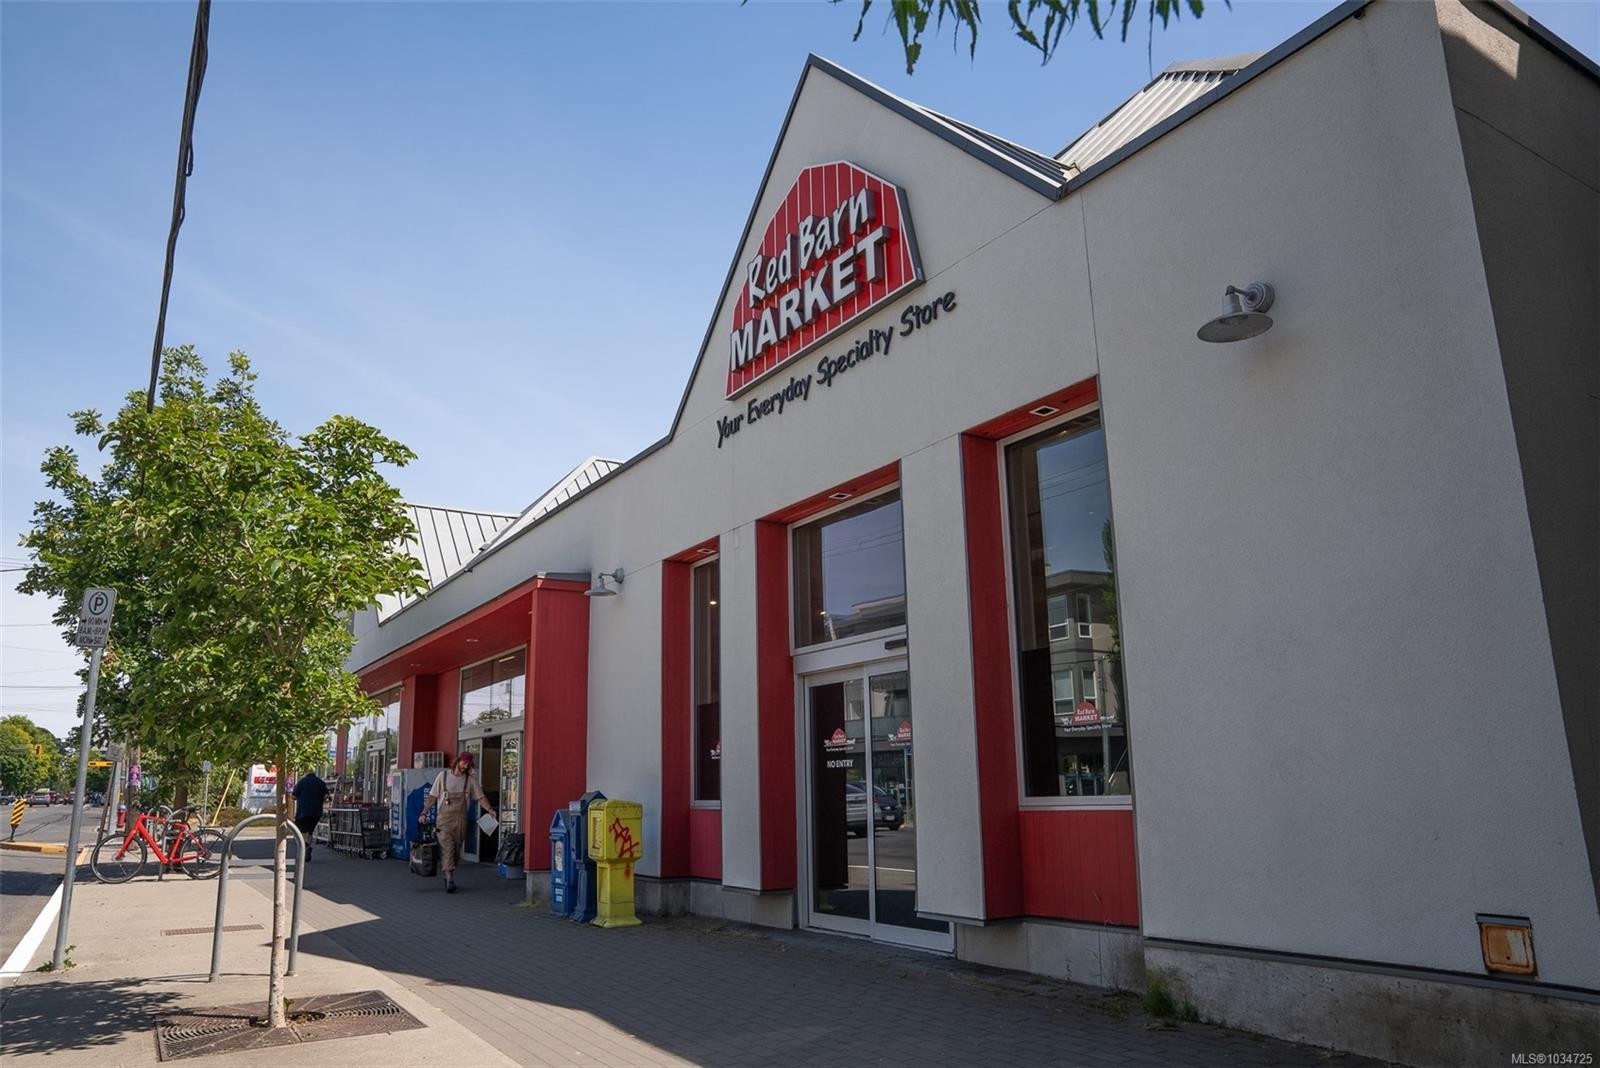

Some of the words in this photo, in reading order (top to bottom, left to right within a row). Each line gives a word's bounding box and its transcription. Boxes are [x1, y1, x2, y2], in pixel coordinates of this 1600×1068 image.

[730, 227, 887, 371] MARKET
[747, 233, 795, 308] Red
[799, 188, 872, 269] Barn
[717, 414, 744, 448] Your
[747, 374, 812, 425] Everyday
[816, 326, 894, 387] Specialty
[900, 289, 957, 338] Store
[827, 760, 836, 768] NO
[836, 759, 853, 768] ENTRY
